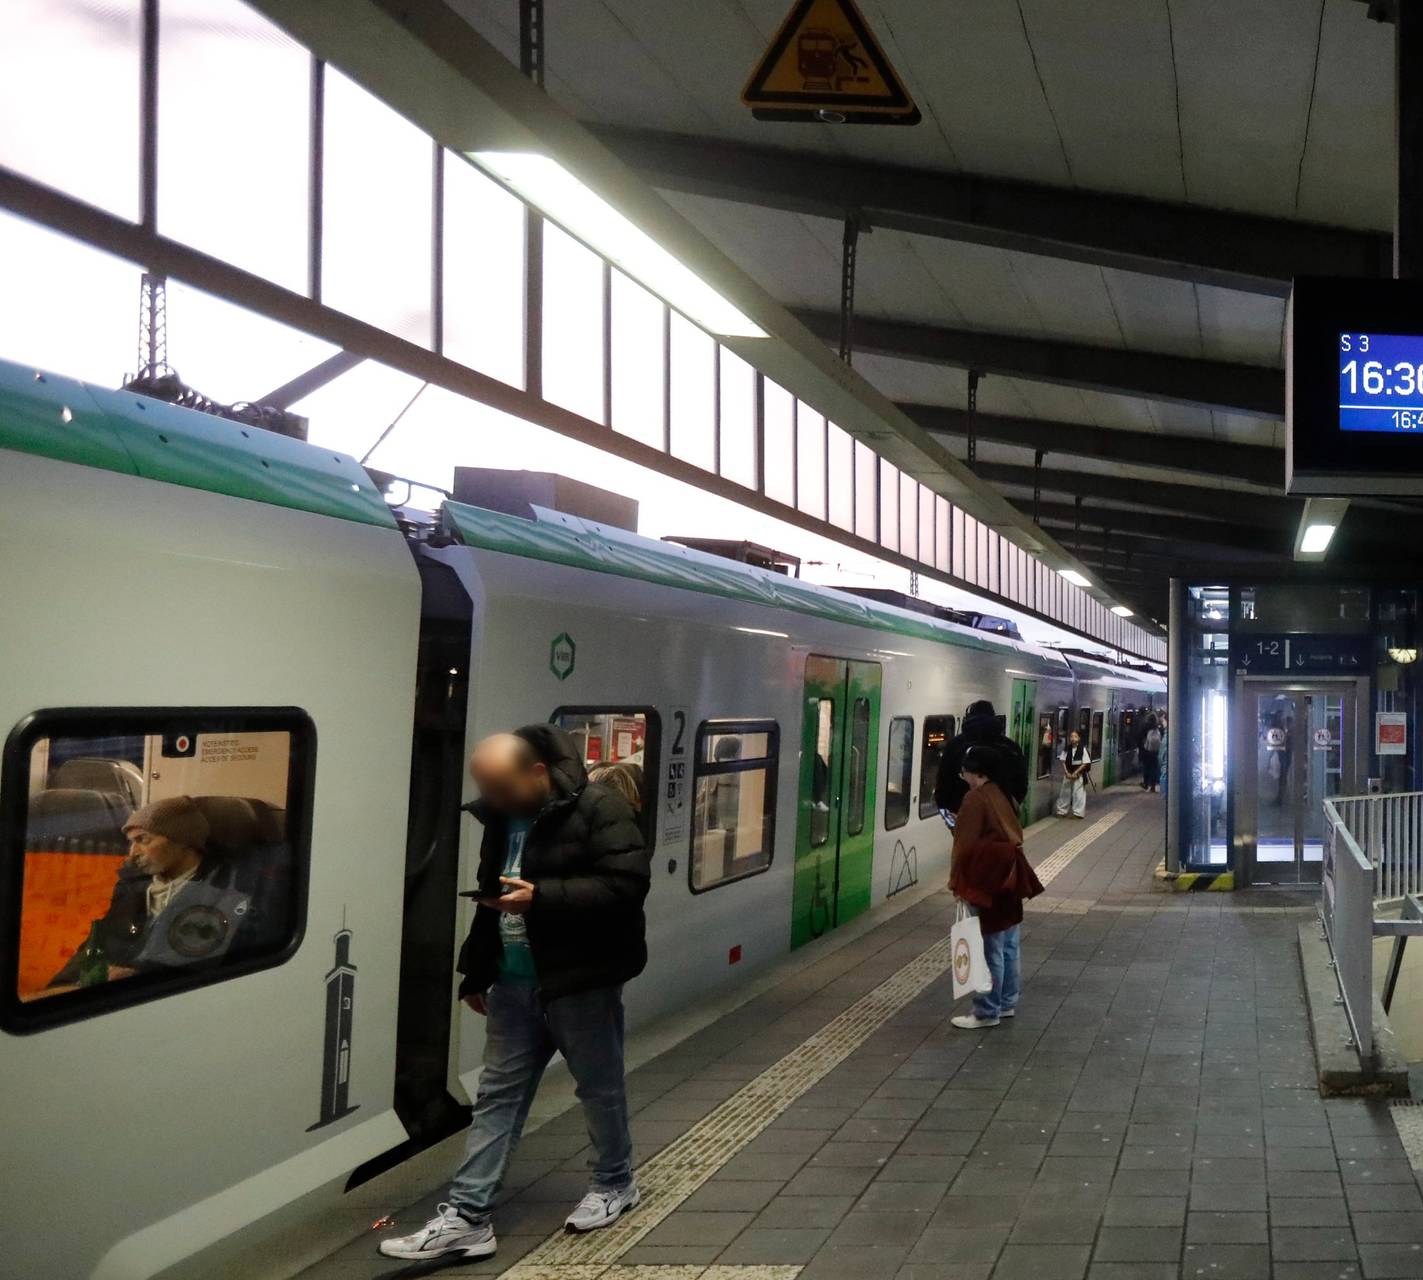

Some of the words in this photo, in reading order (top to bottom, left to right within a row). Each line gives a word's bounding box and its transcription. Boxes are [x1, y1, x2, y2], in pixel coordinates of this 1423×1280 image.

[1341, 335, 1351, 352] S
[1359, 335, 1369, 352] 3
[1257, 640, 1280, 655] 1-2
[672, 710, 686, 755] 2
